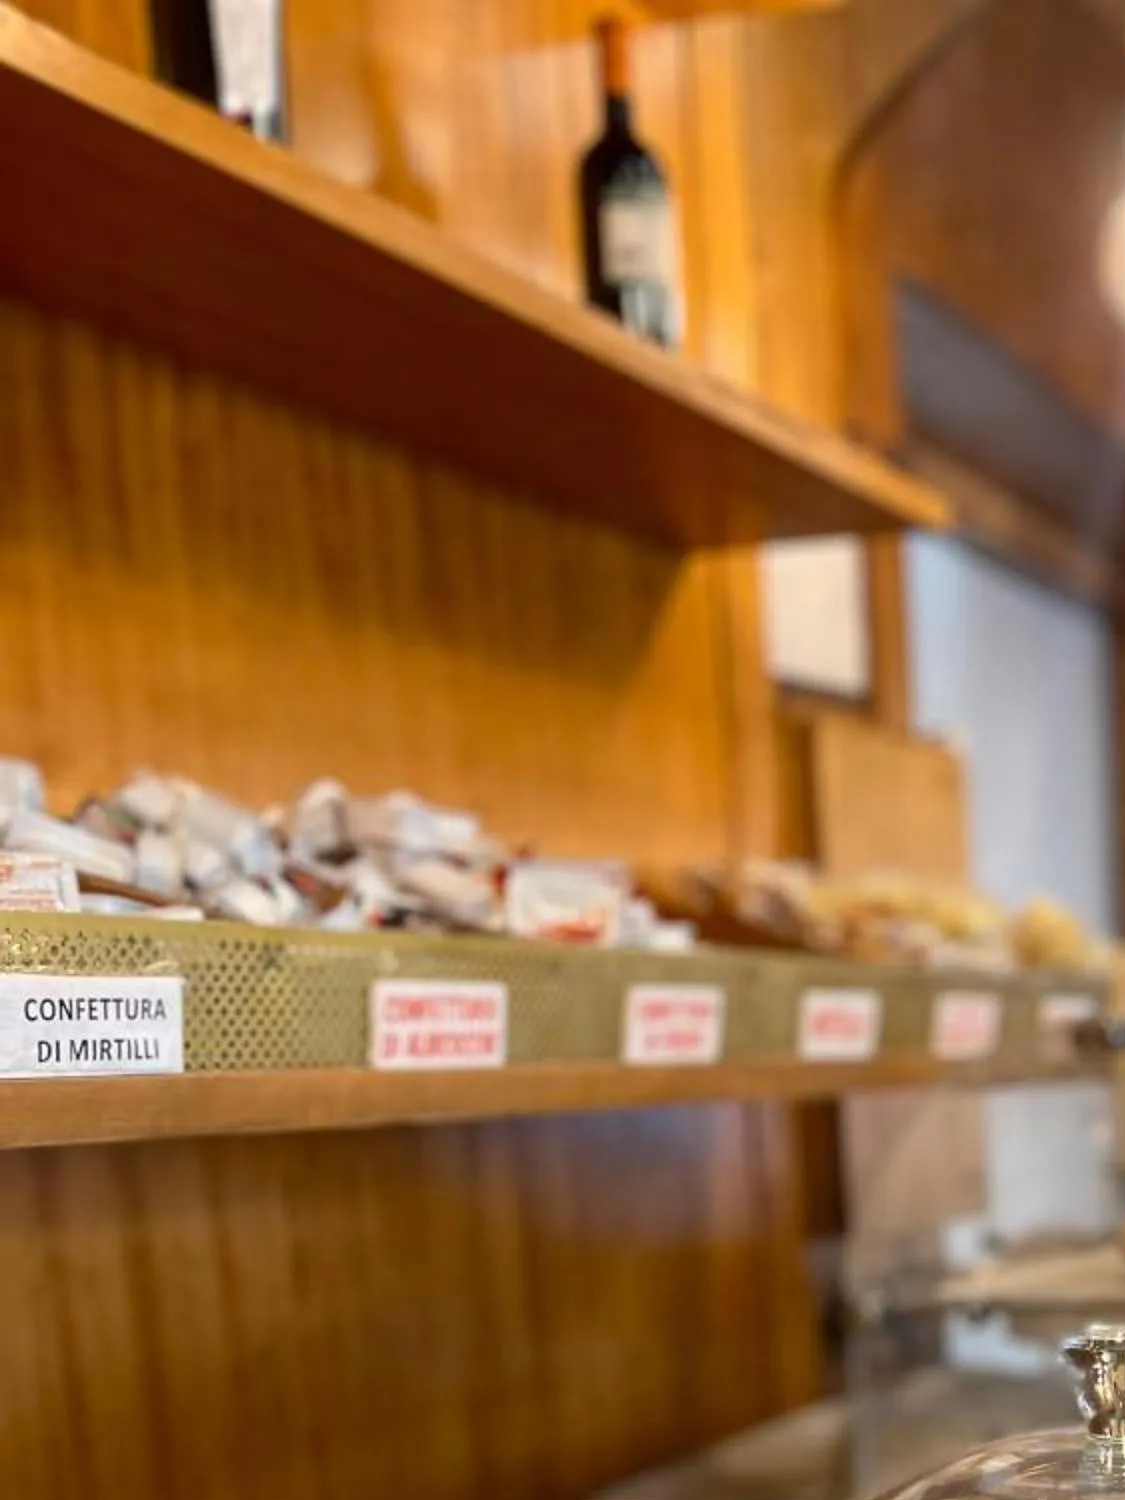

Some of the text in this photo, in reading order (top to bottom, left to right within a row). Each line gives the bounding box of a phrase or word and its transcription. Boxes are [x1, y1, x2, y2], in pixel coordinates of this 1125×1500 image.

[24, 998, 167, 1021] CONFETTURA
[37, 1038, 160, 1063] DI MIRTILLI
